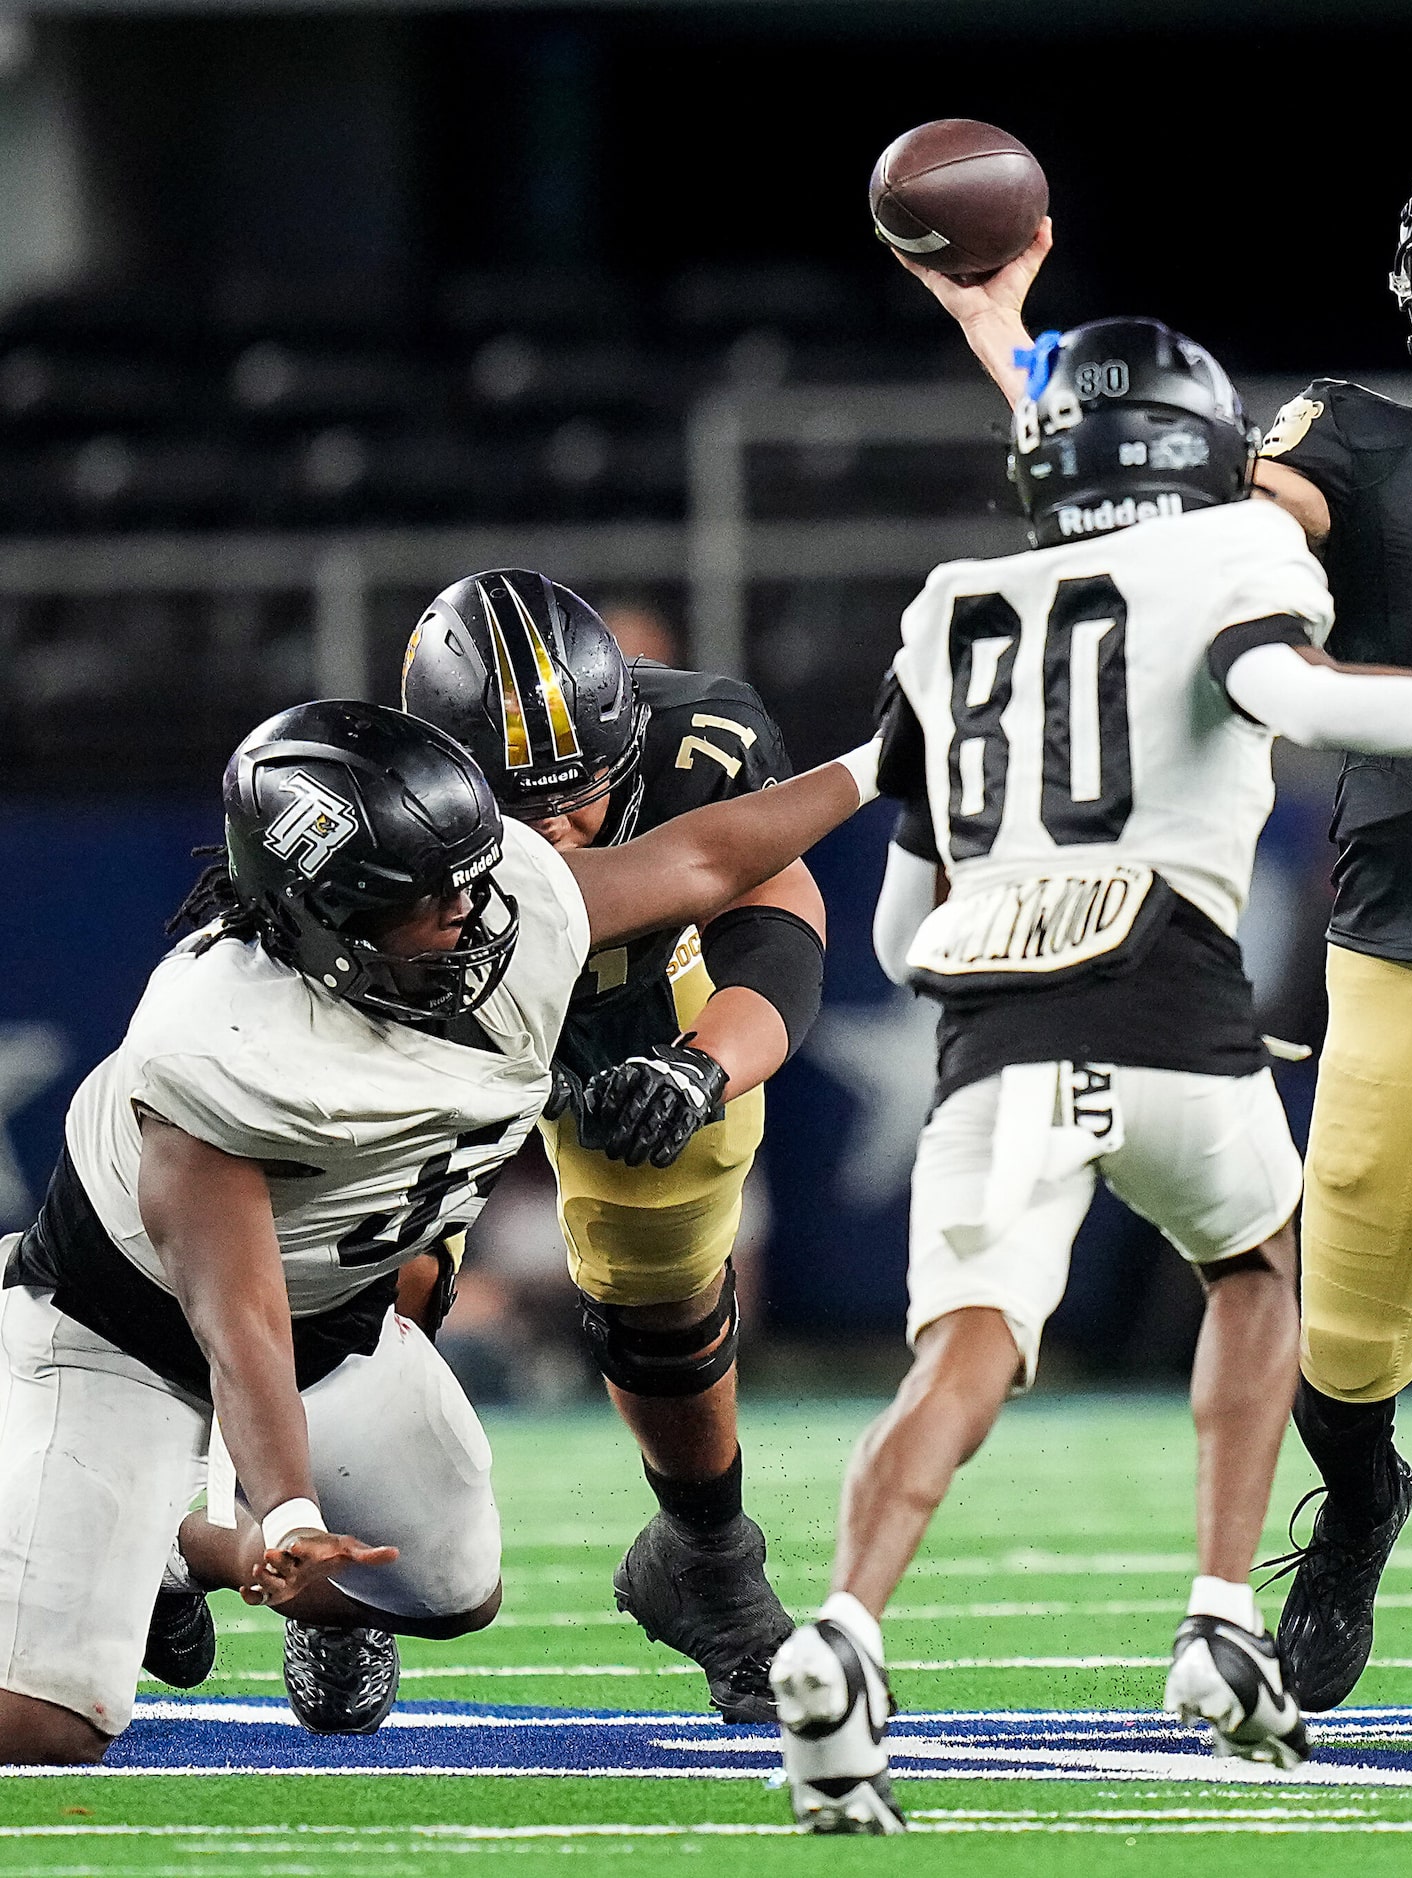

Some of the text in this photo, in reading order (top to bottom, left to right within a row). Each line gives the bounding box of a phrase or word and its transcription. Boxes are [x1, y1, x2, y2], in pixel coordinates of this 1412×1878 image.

[1074, 359, 1130, 401] 80
[1058, 493, 1183, 537] Riddell
[947, 574, 1134, 863] 80
[675, 713, 758, 780] 71
[452, 842, 500, 888] Riddell
